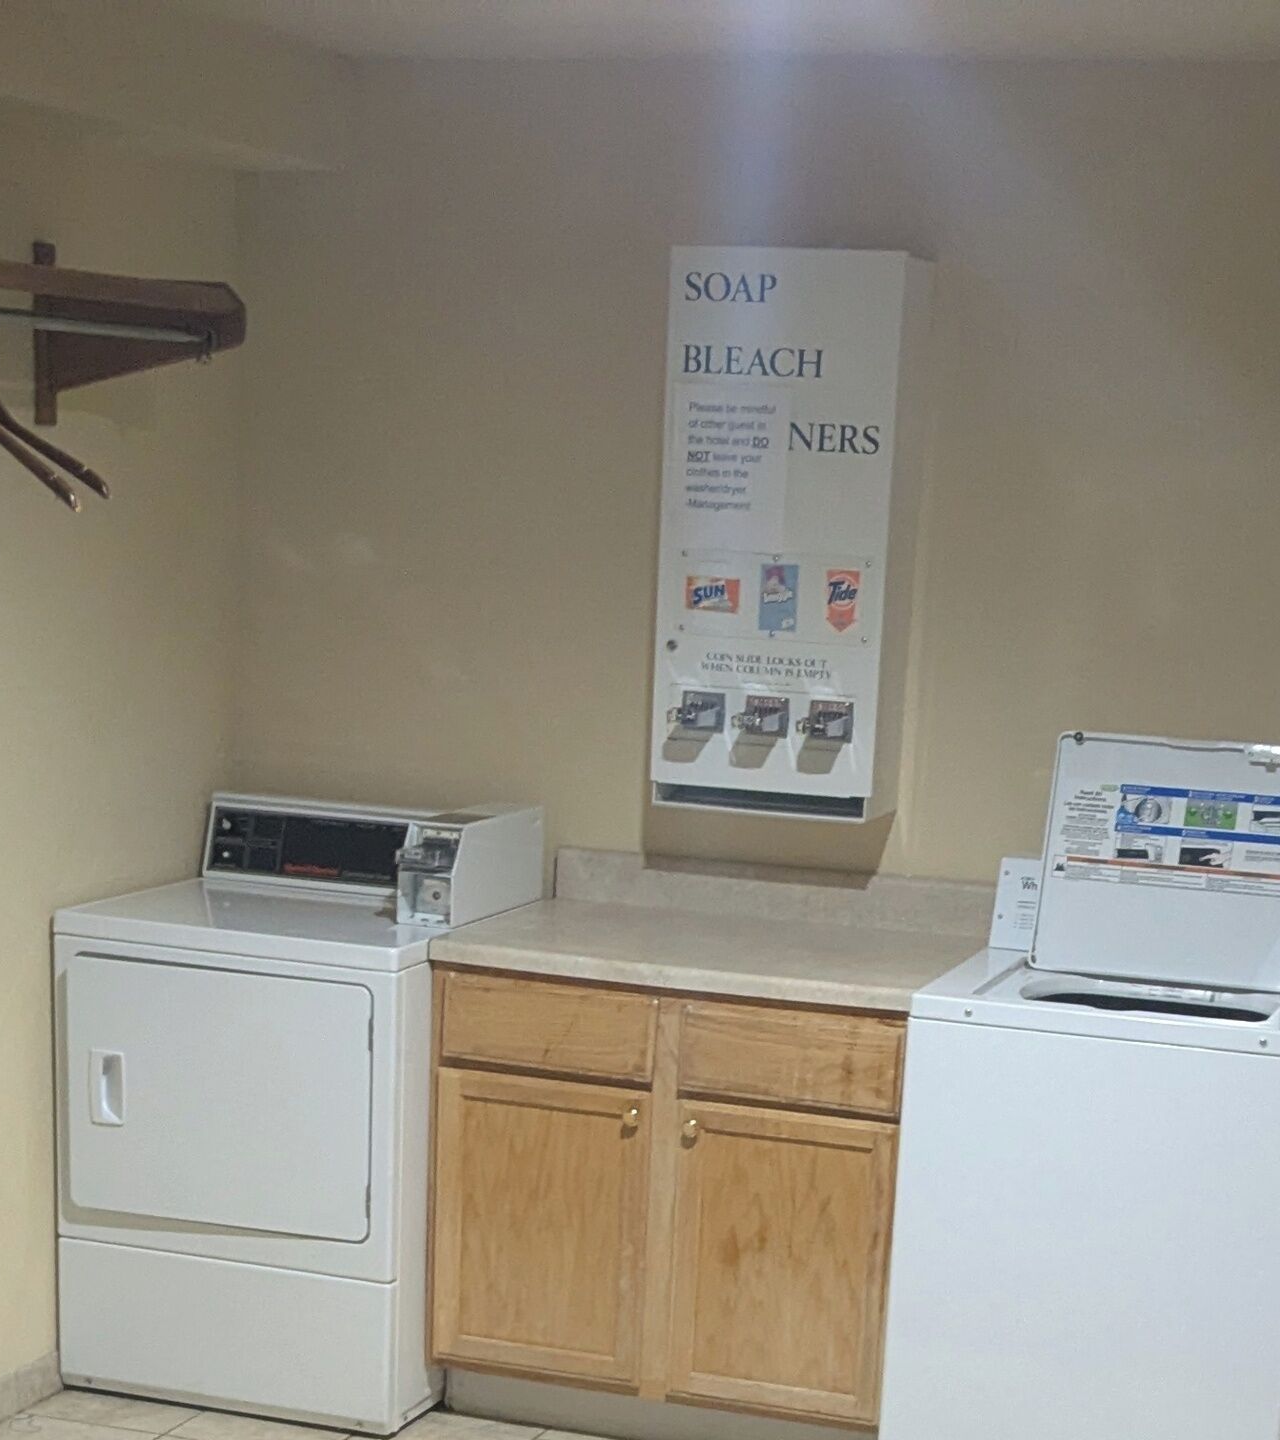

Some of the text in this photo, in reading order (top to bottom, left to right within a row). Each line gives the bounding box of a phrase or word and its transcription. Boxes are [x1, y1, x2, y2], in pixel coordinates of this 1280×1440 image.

[684, 272, 778, 303] SOAP
[682, 344, 824, 378] BLEACH
[688, 401, 723, 413] Please
[752, 436, 769, 448] DO
[687, 450, 711, 462] NOT
[692, 585, 726, 605] SUN
[828, 580, 858, 605] Tide
[705, 652, 733, 662] COIN
[766, 655, 801, 666] LOCKS
[804, 658, 829, 669] OUT
[700, 661, 733, 672] WHEN
[797, 668, 832, 679] EMPTY
